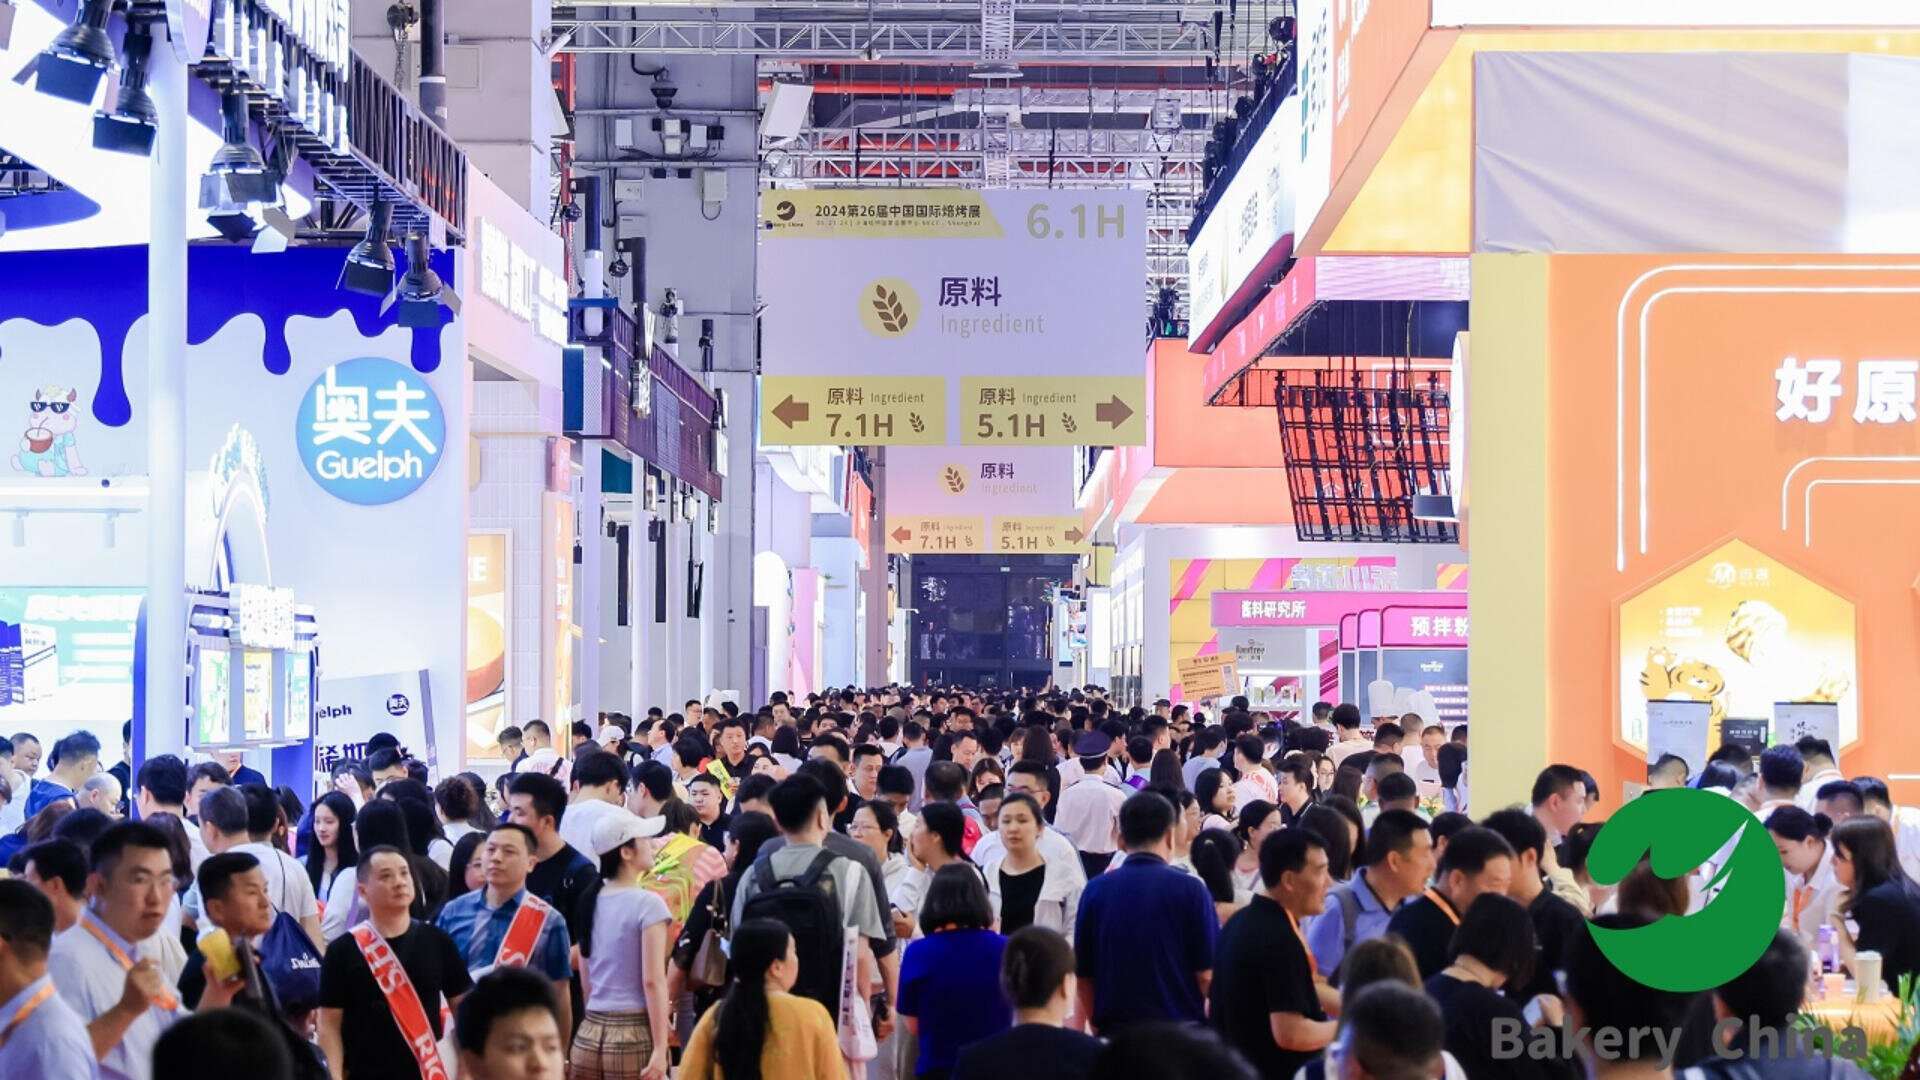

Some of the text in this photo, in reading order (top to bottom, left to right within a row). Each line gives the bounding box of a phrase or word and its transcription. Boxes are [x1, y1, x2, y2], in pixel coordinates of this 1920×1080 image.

[815, 204, 980, 218] 2024第26届中国国际焙烤展
[1027, 204, 1124, 238] 6.1H
[938, 276, 1002, 307] 原料
[940, 313, 1044, 338] Ingredient
[827, 387, 925, 406] 原料 Ingredient
[979, 387, 1077, 406] 原料 Ingredient
[311, 365, 437, 454] 奥夫
[826, 413, 894, 438] 7.1H
[977, 413, 1045, 438] 5.1H
[316, 451, 423, 482] Guelph
[980, 462, 1015, 479] 原料
[920, 535, 957, 549] 7.1H
[1001, 535, 1038, 550] 5.1H
[319, 704, 352, 719] elph
